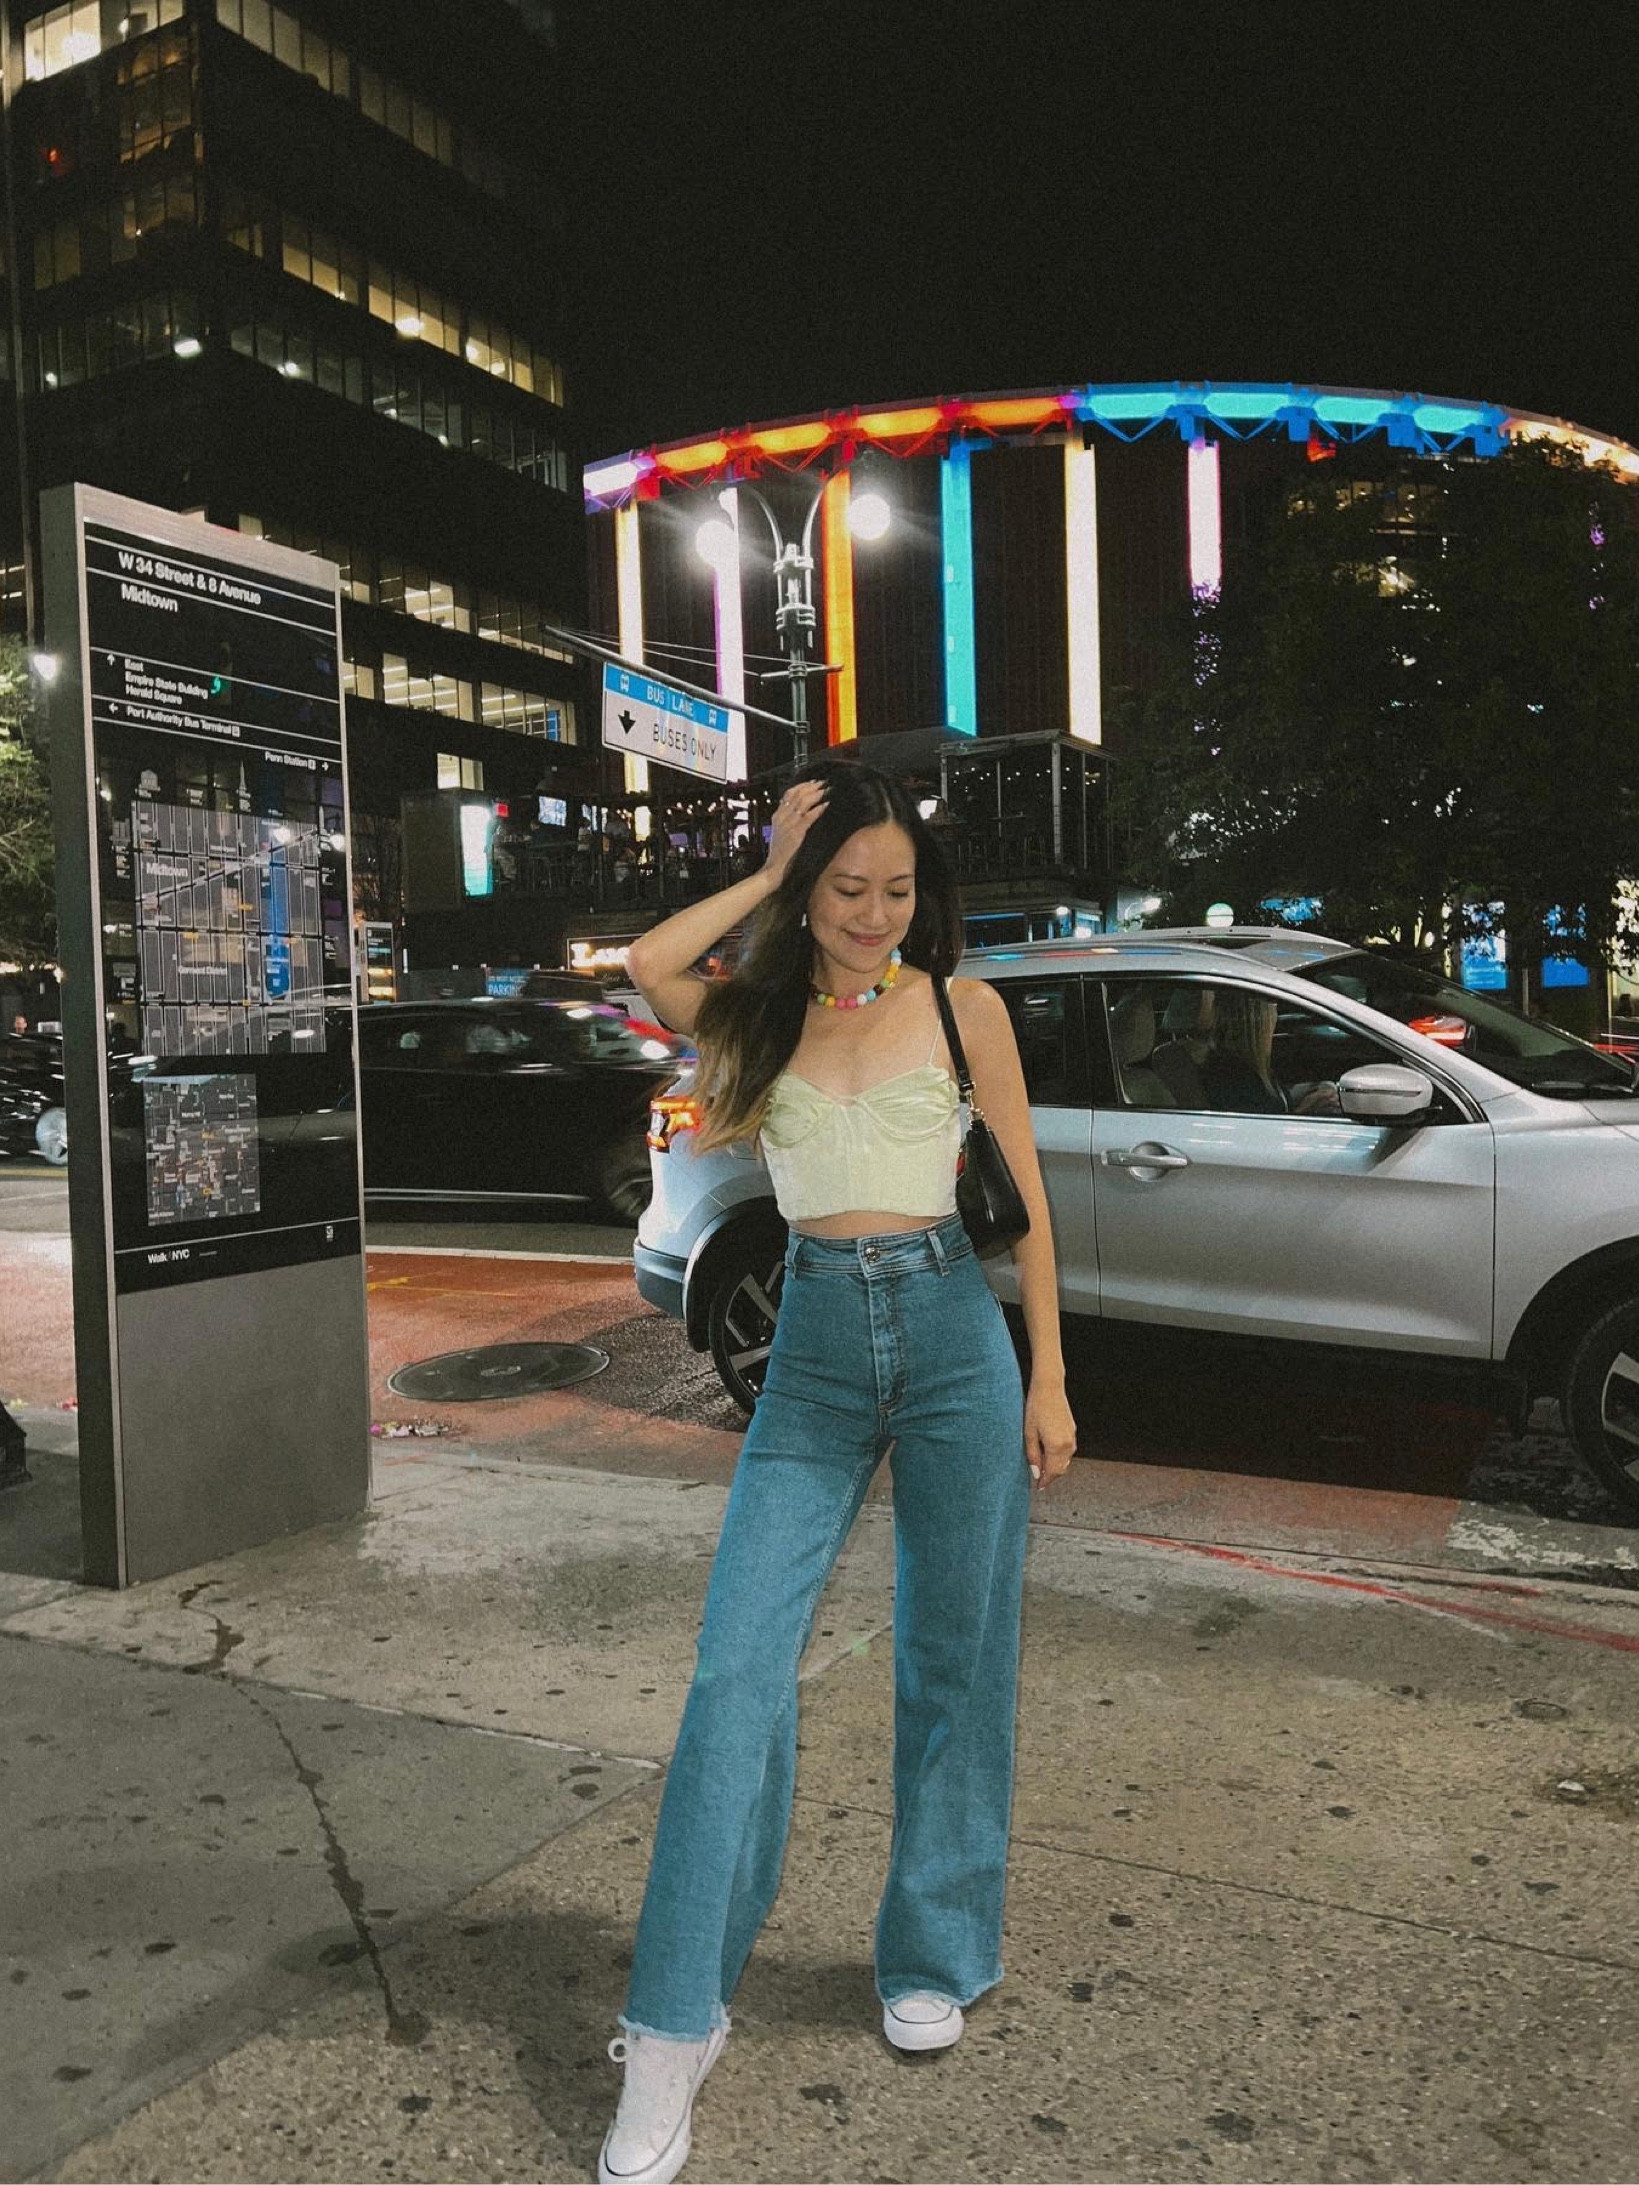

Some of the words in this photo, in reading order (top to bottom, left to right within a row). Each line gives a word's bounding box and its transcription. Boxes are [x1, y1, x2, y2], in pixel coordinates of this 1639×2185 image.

[118, 551, 134, 570] W
[136, 556, 153, 576] 34
[155, 561, 194, 587] Street
[197, 573, 207, 591] &
[219, 580, 261, 604] Avenue
[121, 583, 178, 613] Midtown
[125, 658, 144, 672] East
[125, 671, 154, 687] Empire
[155, 677, 177, 692] State
[178, 682, 208, 700] Building
[646, 685, 665, 706] BUS
[672, 694, 694, 717] LANE
[127, 705, 145, 719] Port
[146, 709, 183, 727] Authority
[184, 716, 199, 728] Bus
[201, 719, 232, 735] Terminal
[653, 723, 687, 752] BUSES
[691, 737, 717, 761] ONLY
[265, 751, 283, 763] Penn
[284, 755, 308, 767] Station
[147, 862, 188, 877] Midtown
[147, 1252, 168, 1263] Walk
[172, 1248, 190, 1260] NYC
